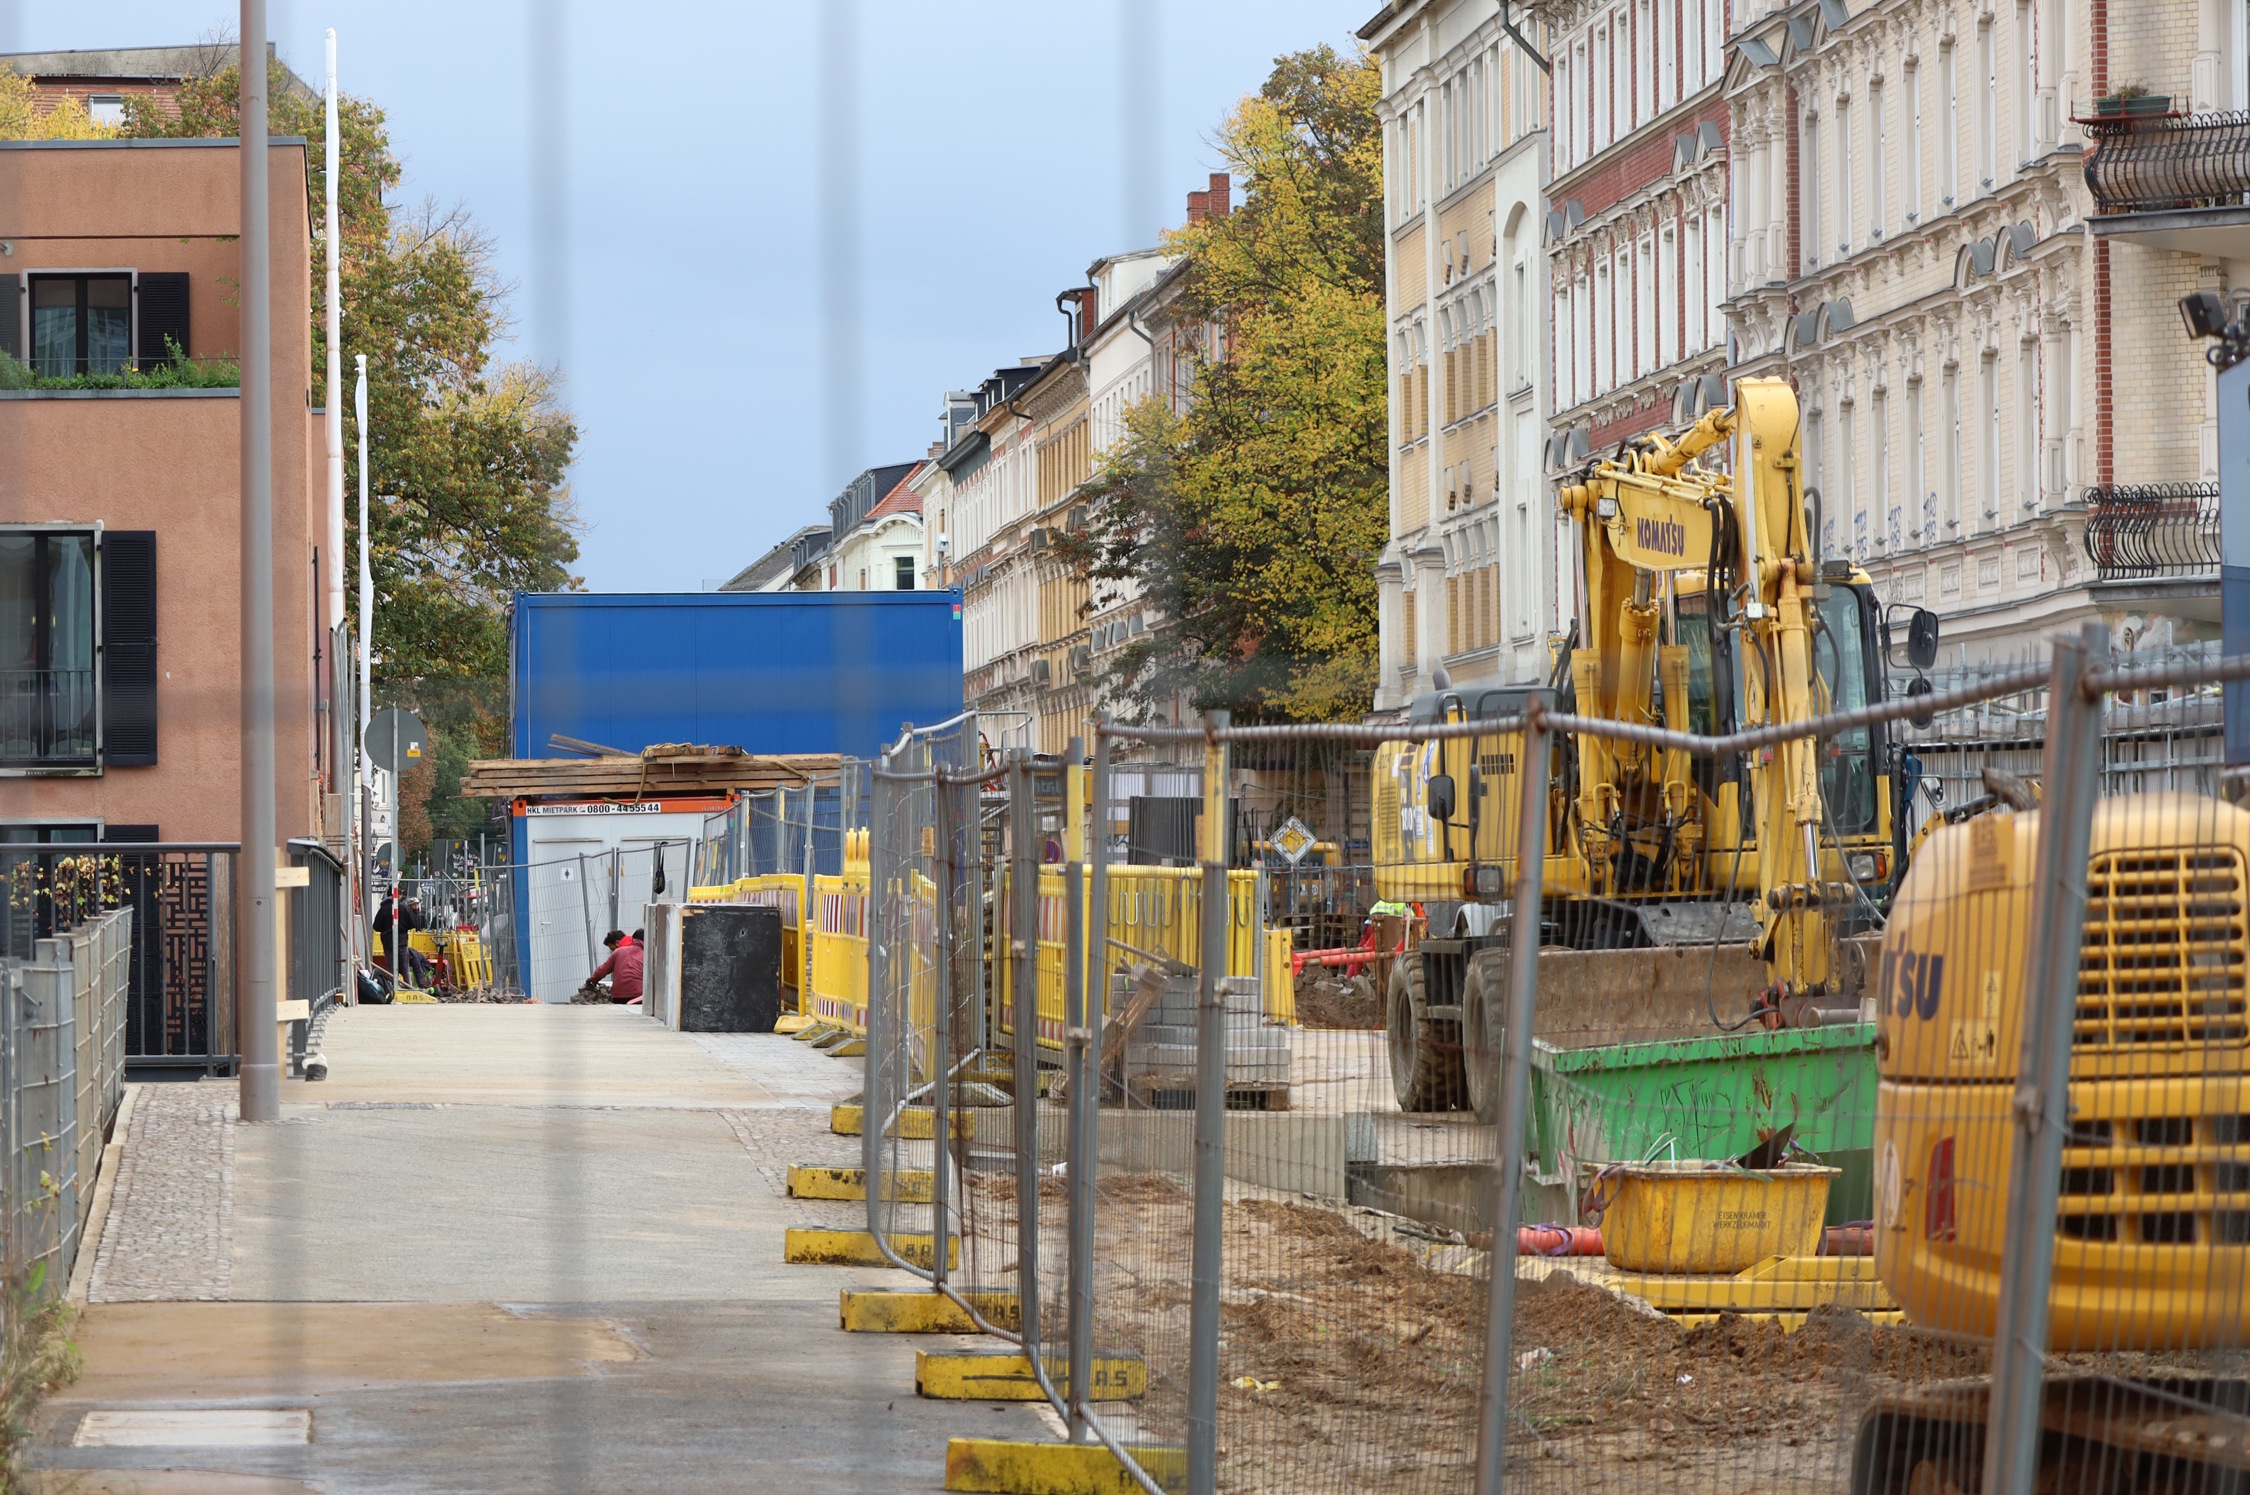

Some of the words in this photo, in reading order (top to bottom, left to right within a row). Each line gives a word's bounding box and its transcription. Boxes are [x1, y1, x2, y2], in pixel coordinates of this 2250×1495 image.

[1637, 514, 1685, 557] KOMATSU
[526, 806, 541, 814] HKL
[542, 805, 578, 814] MIETPARK
[1718, 1211, 1738, 1220] EISEN
